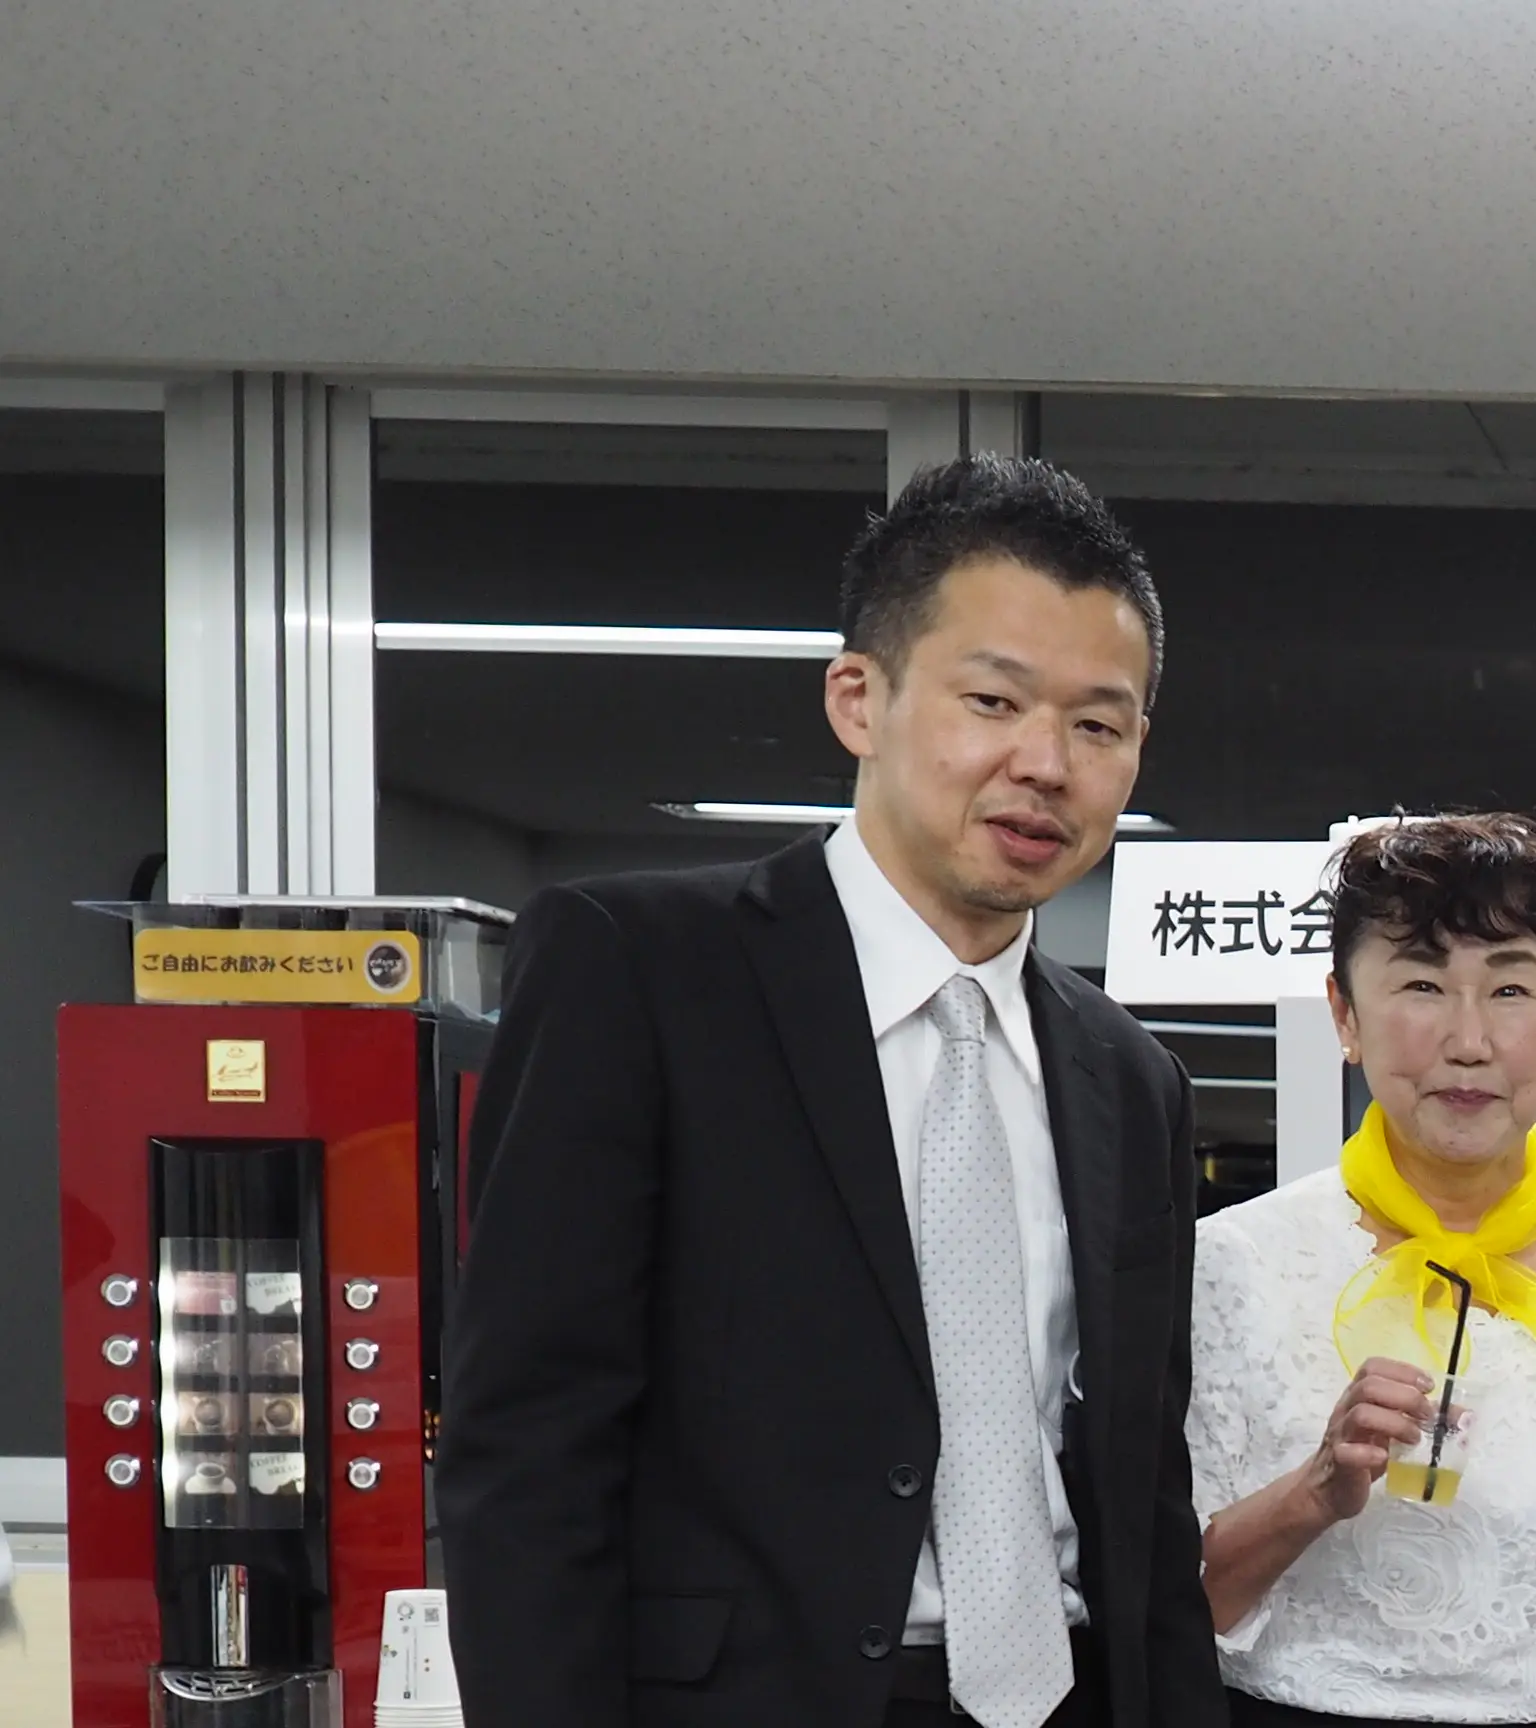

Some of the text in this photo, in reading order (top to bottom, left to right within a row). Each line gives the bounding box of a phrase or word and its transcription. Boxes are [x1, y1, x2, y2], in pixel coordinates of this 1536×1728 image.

[142, 955, 354, 974] ご自由にお飲みください
